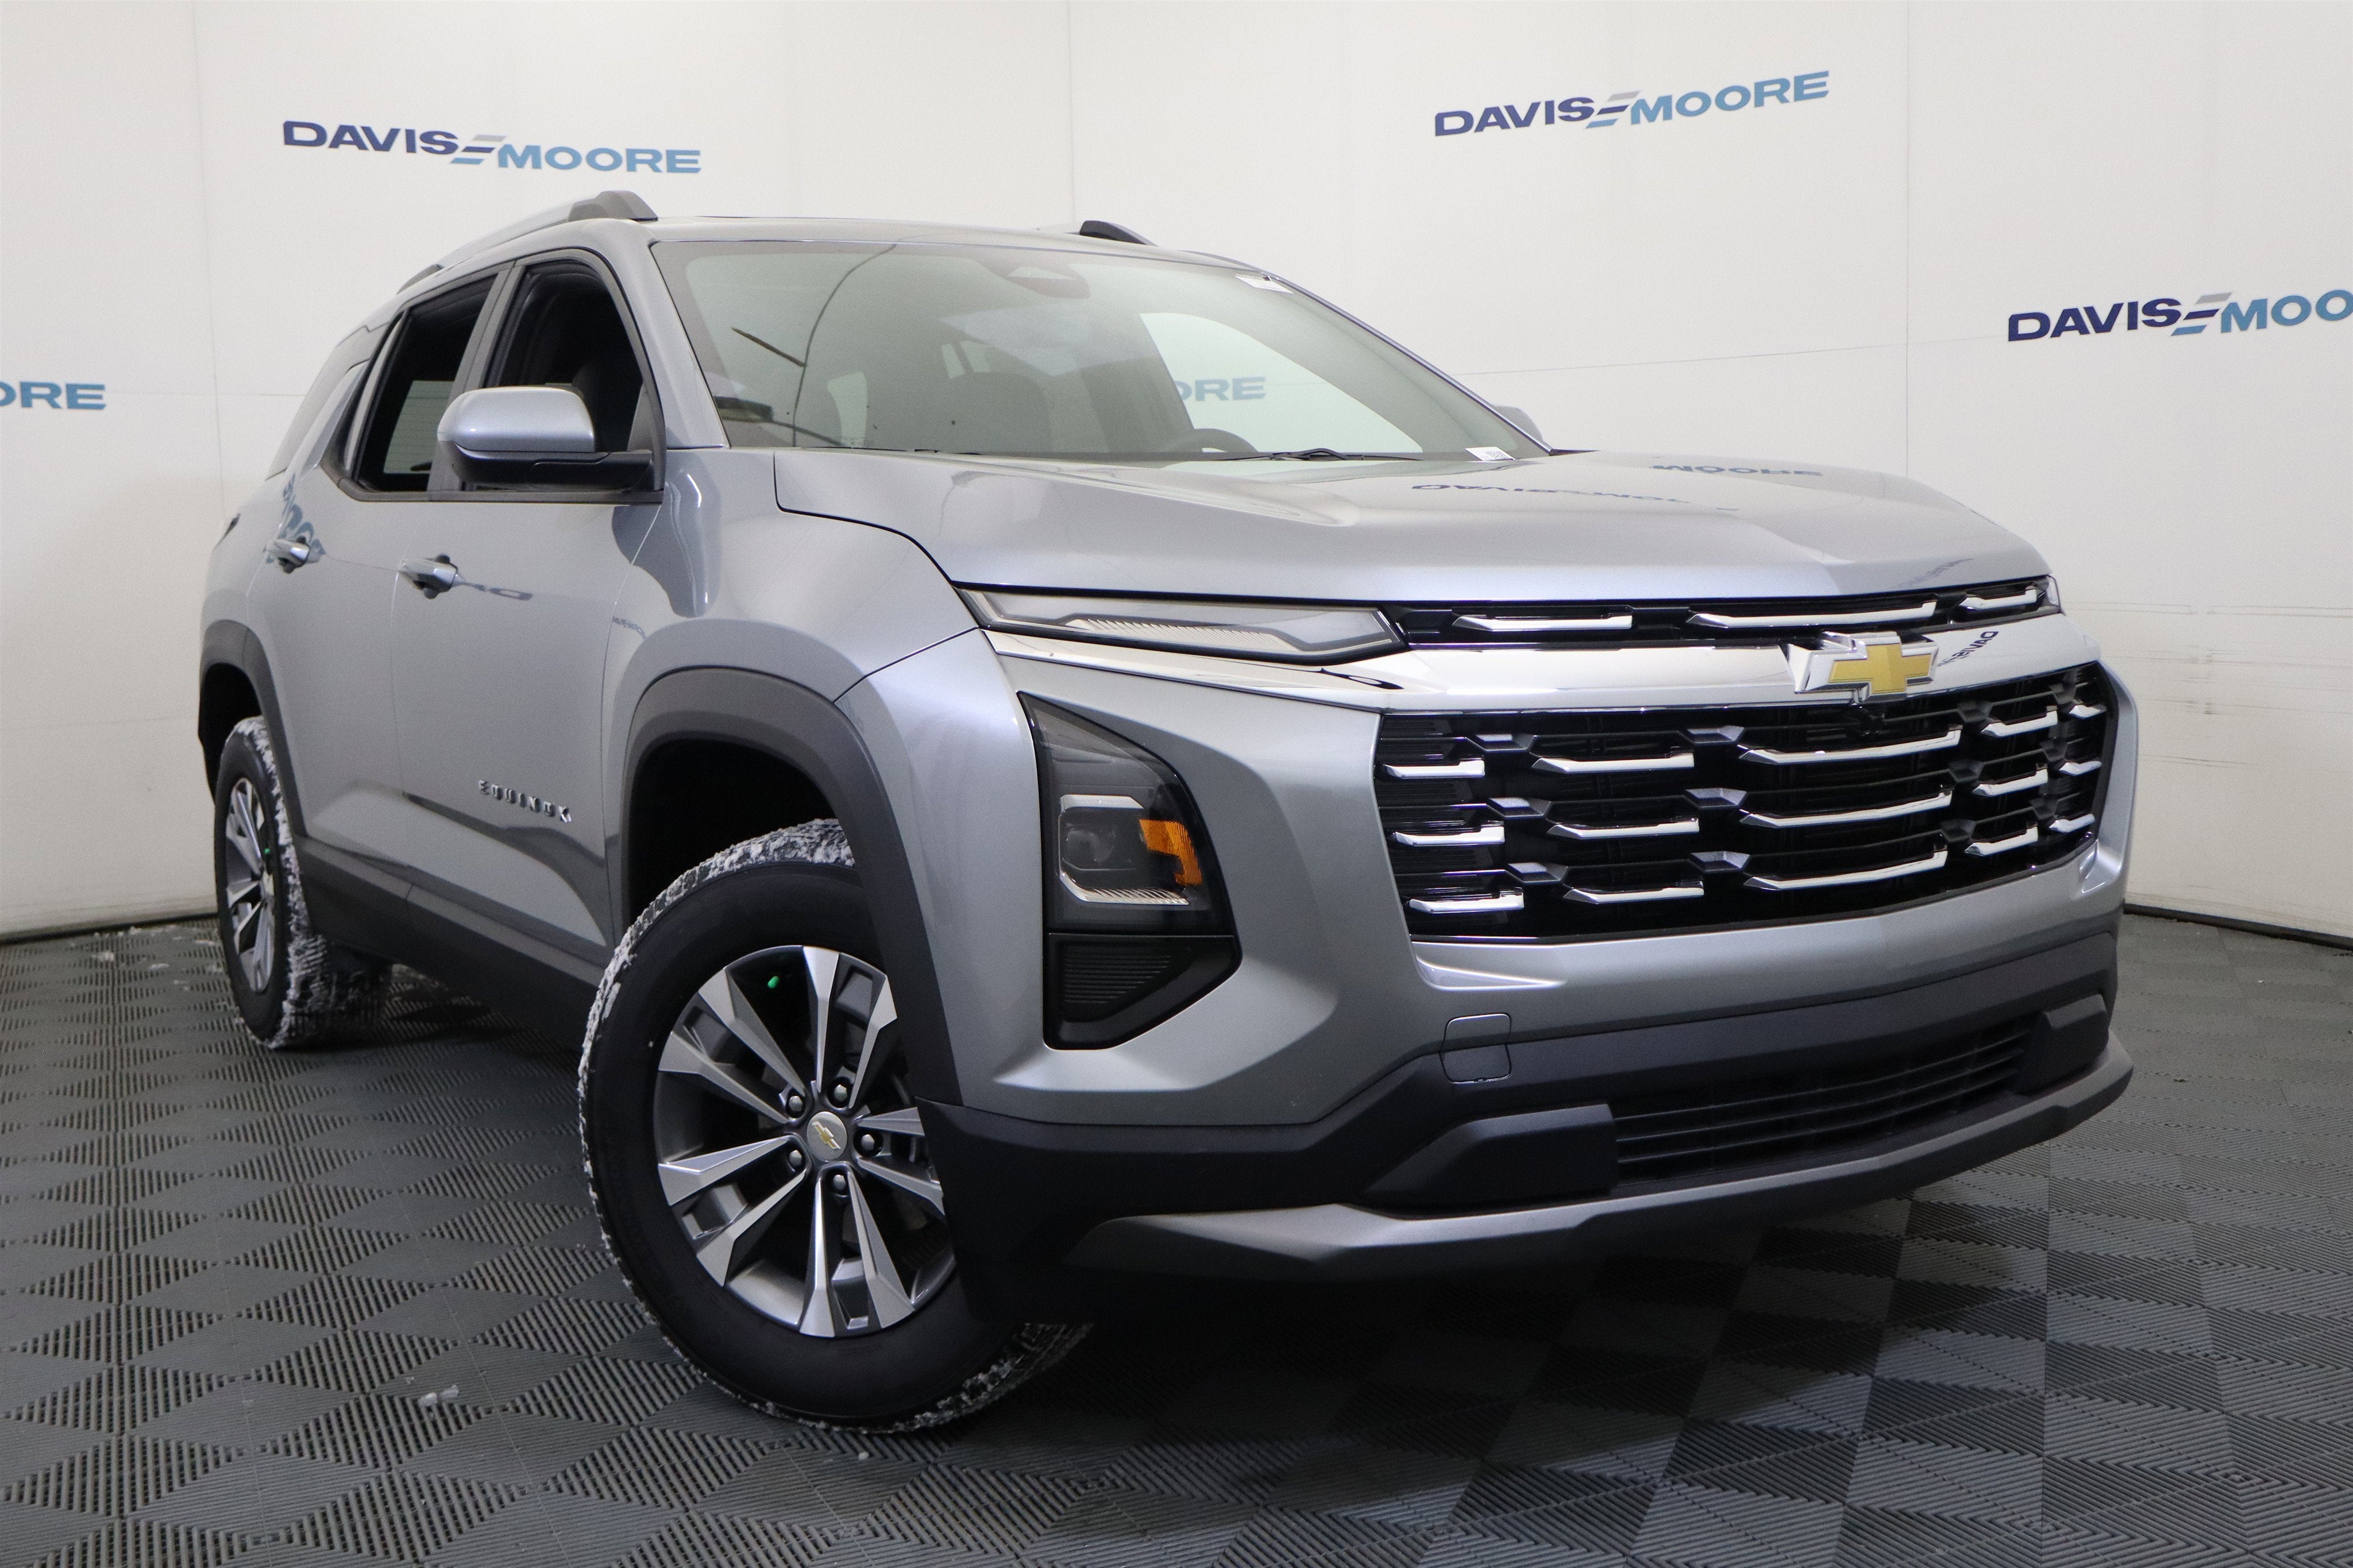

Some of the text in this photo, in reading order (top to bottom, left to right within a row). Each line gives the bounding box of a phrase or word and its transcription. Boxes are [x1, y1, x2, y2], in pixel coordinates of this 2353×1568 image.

[1434, 70, 1830, 137] DAVIS MOORE
[283, 120, 701, 173] DAVIS MOORE
[2008, 289, 2353, 342] DAVIS MOO
